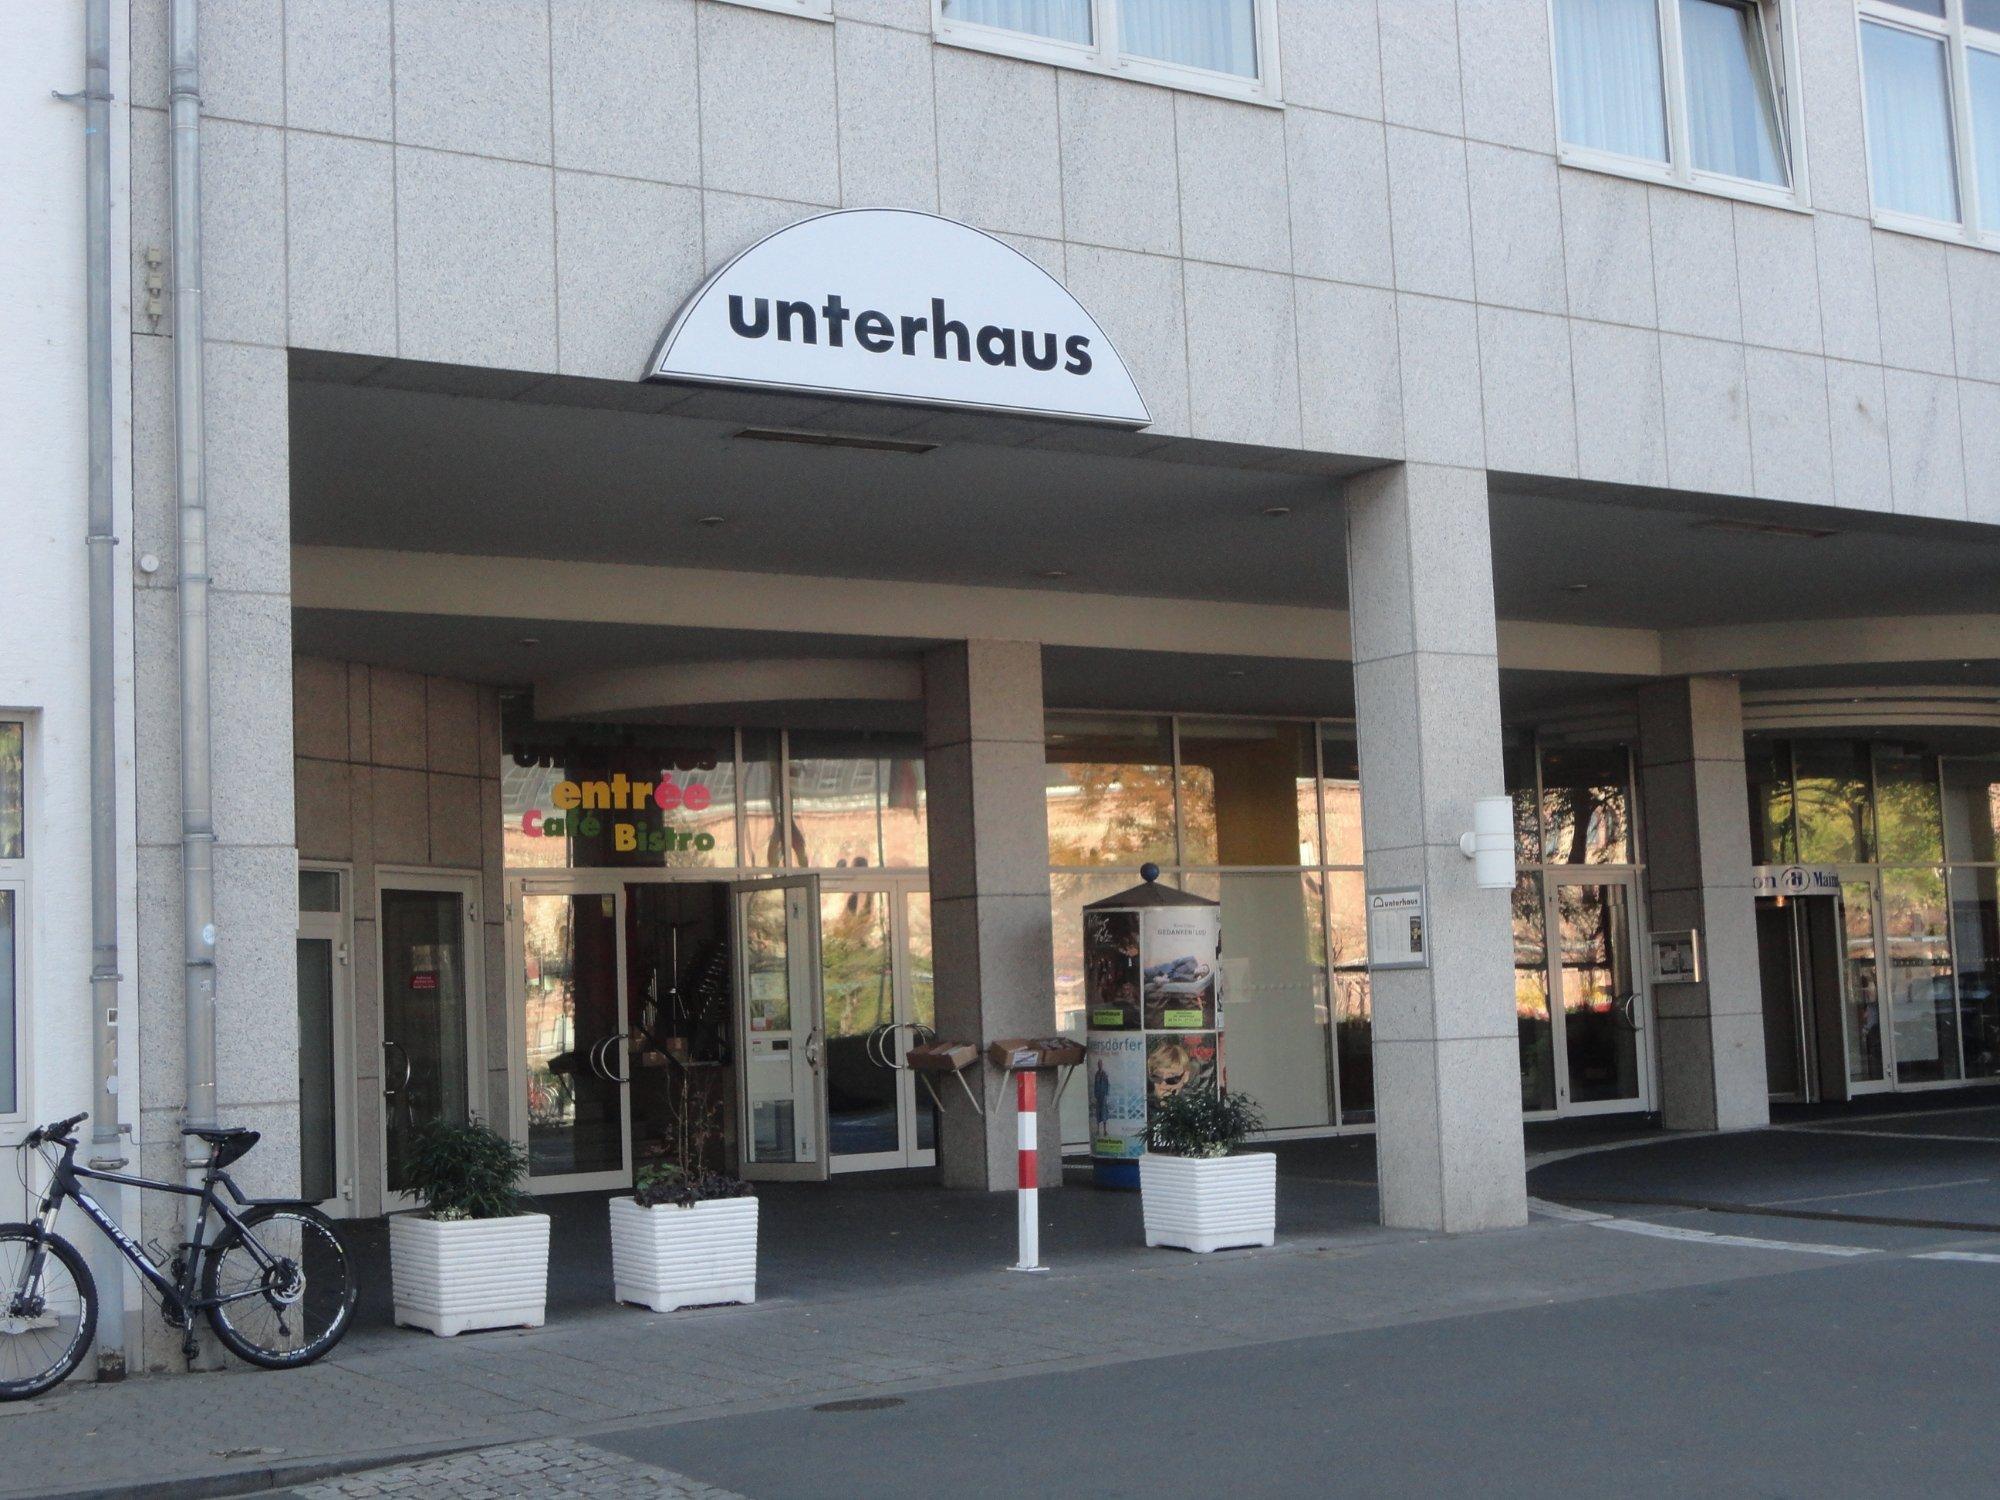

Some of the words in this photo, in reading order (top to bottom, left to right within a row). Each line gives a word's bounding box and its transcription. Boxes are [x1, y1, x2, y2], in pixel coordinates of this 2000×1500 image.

[727, 293, 1093, 376] unterhaus
[553, 773, 711, 811] entrée
[615, 821, 715, 852] Bistro
[1384, 898, 1418, 907] unterhaus
